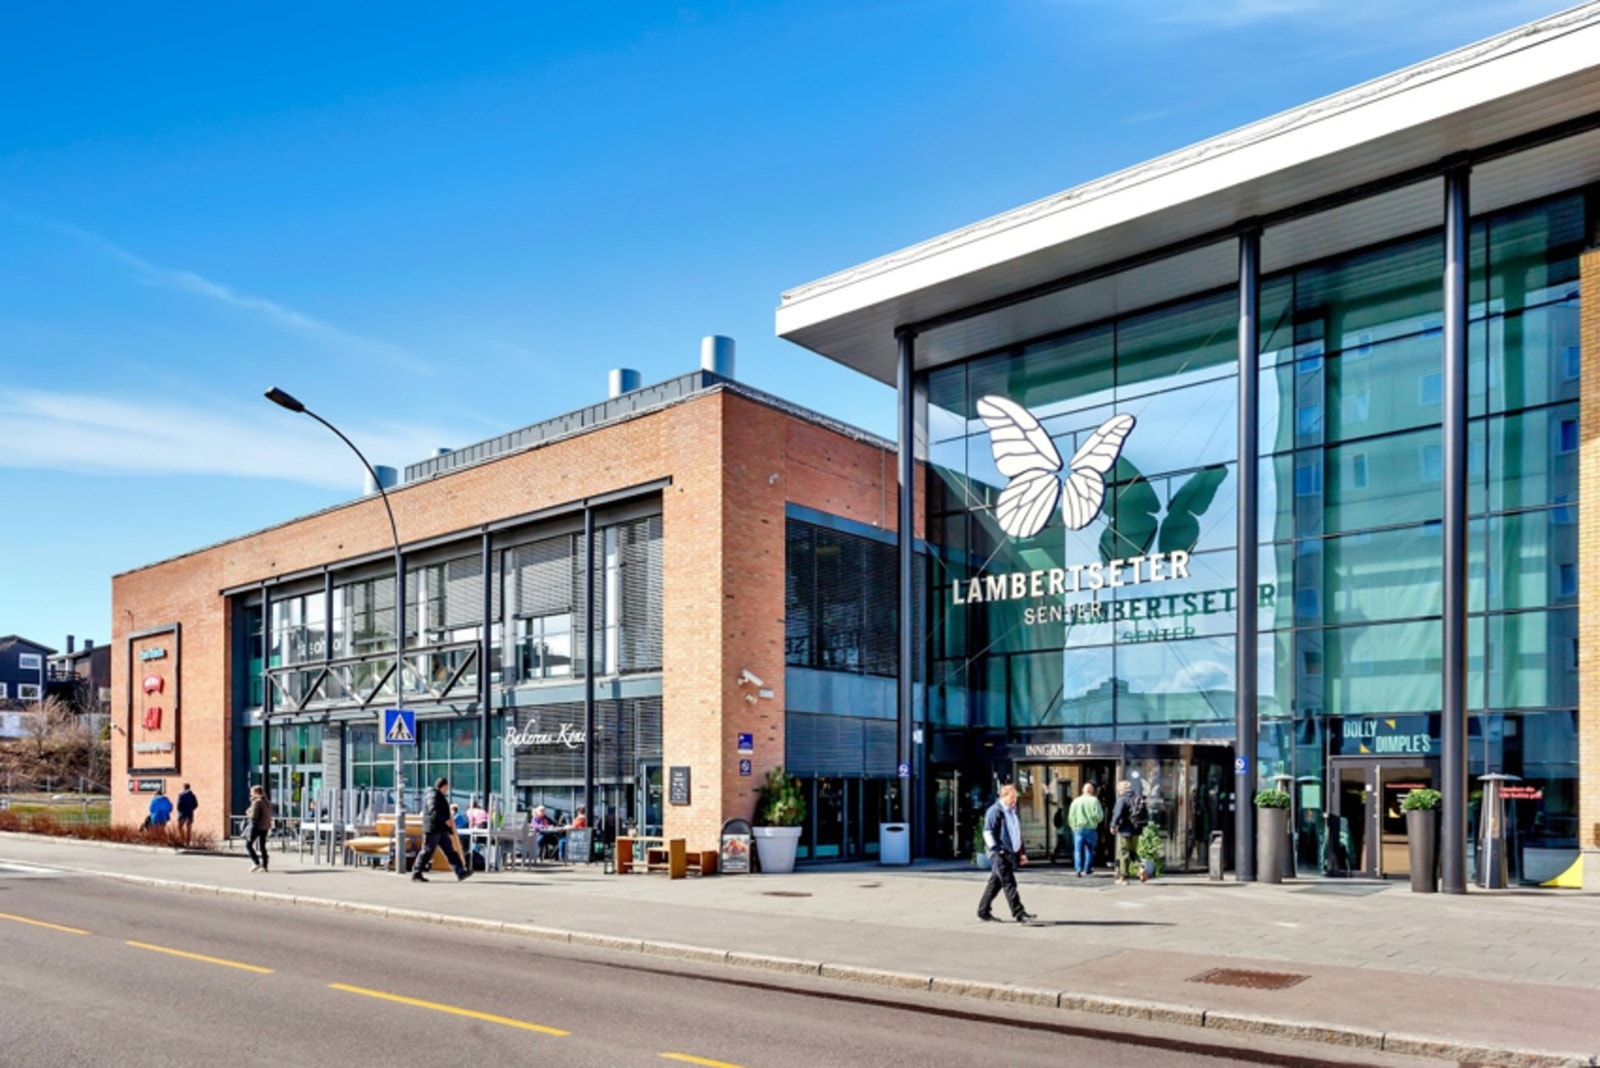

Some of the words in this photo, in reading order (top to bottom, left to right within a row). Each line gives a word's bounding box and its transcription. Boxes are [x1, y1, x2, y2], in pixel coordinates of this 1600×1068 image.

[952, 550, 1190, 605] LAMBERTSETER
[1023, 600, 1103, 626] SENTER
[1343, 720, 1378, 738] DOLLY
[1025, 743, 1074, 756] INNGANG
[1077, 743, 1092, 755] 21
[1375, 733, 1432, 753] DIMPLE'S
